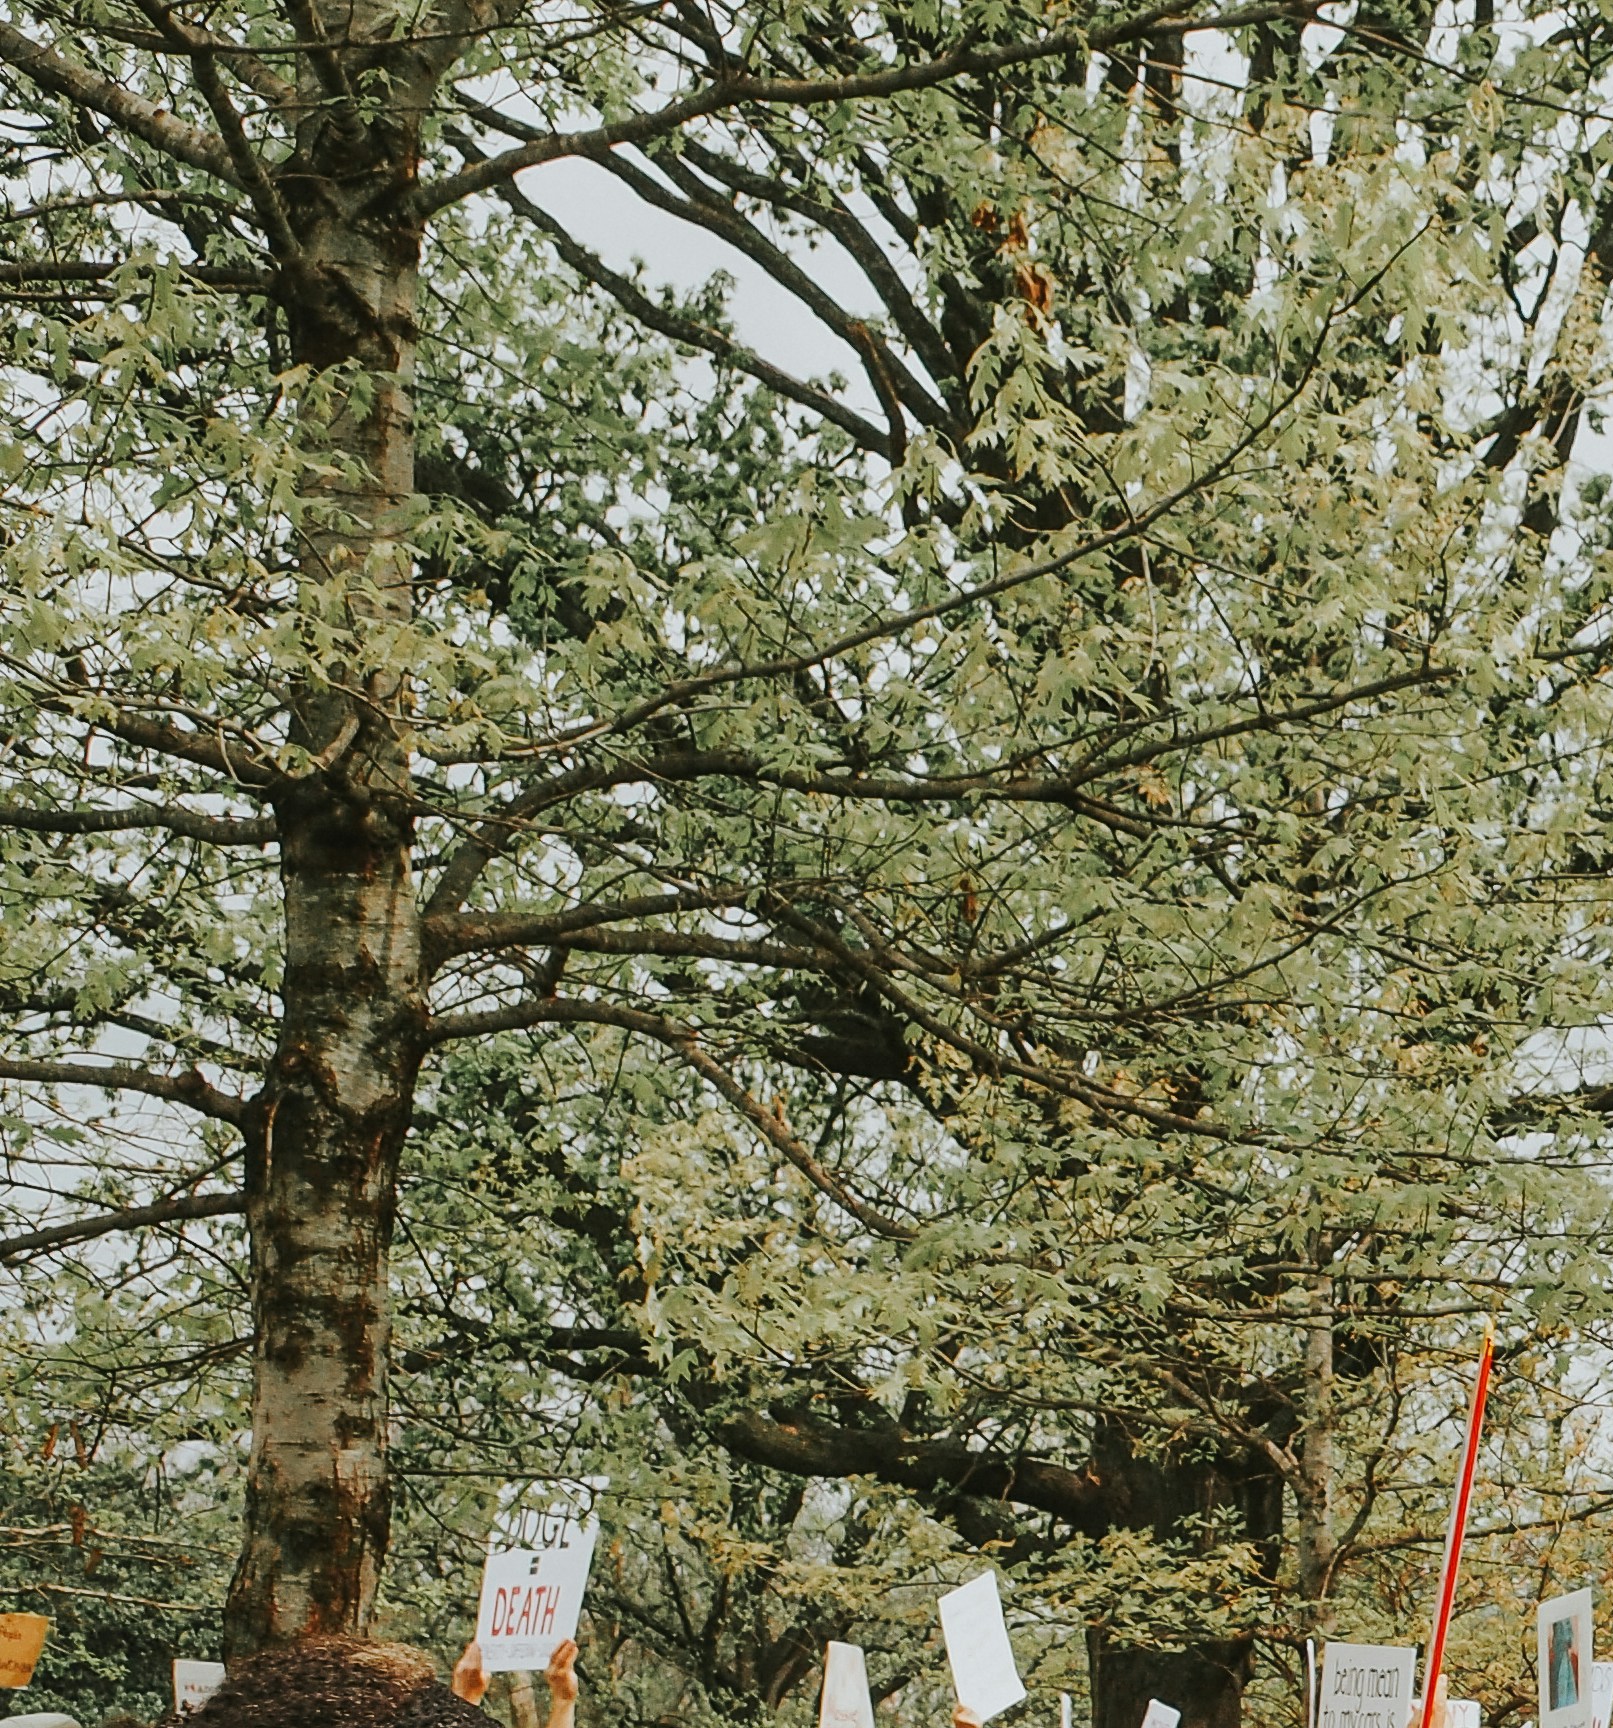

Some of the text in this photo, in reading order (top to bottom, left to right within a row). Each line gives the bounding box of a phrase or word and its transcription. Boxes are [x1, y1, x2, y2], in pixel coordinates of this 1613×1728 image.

[491, 1586, 561, 1637] DEATH
[1334, 1657, 1400, 1713] being mean
